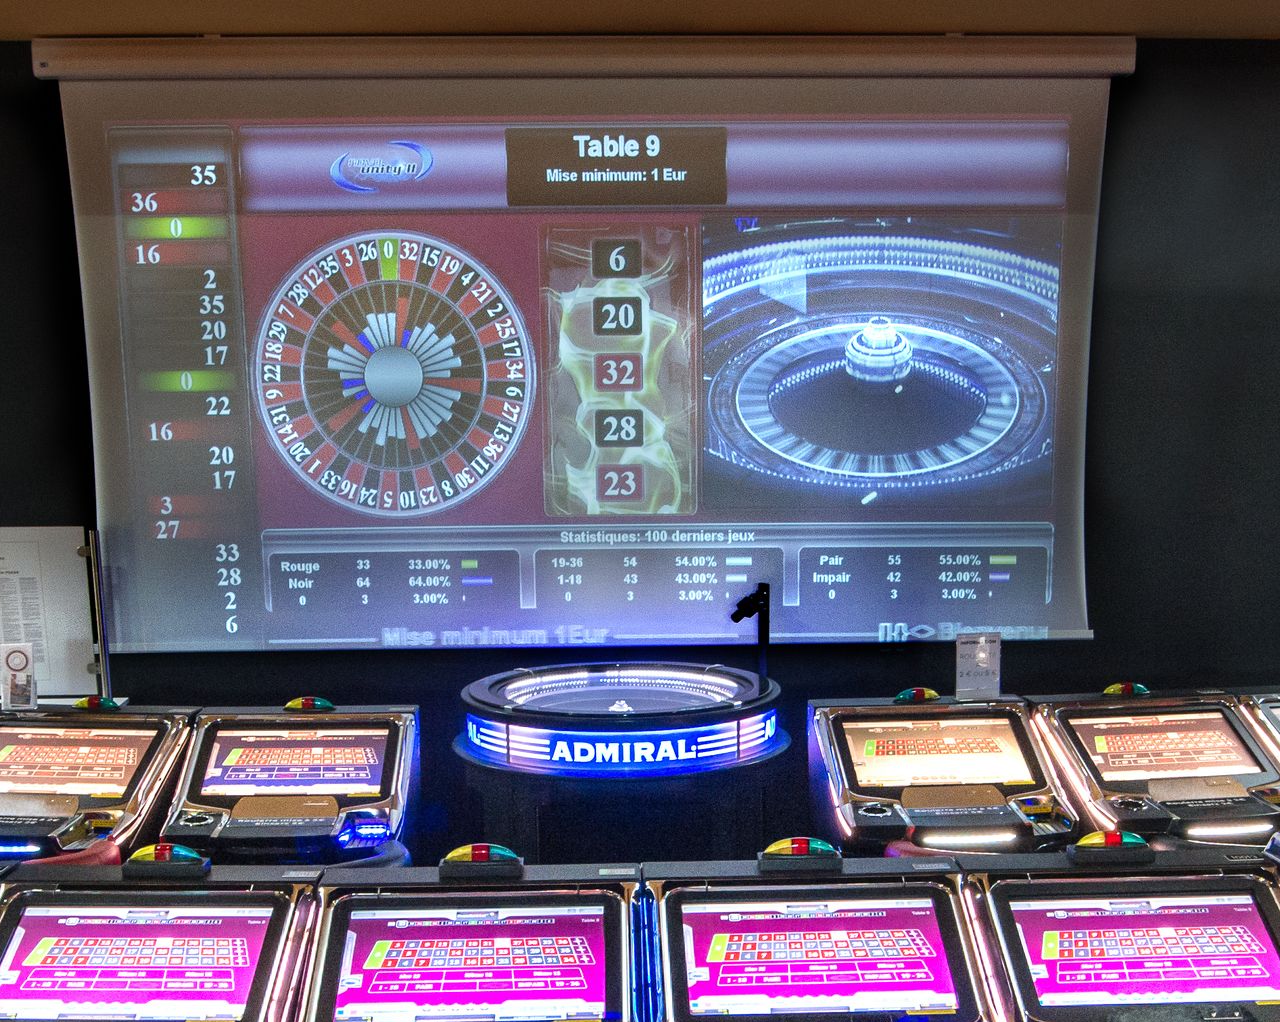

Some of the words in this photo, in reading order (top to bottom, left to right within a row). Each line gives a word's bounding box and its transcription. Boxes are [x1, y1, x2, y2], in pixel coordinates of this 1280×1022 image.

[573, 135, 640, 158] Table
[645, 135, 660, 158] 9
[191, 165, 217, 185] 35
[546, 168, 578, 182] Mise
[582, 168, 647, 182] minimum:
[652, 168, 659, 181] 1
[663, 168, 687, 181] Eur
[131, 192, 158, 212] 36
[170, 218, 182, 238] 0
[136, 244, 160, 264] 16
[342, 248, 353, 267] 3
[358, 241, 377, 261] 26
[383, 241, 393, 259] 0
[400, 242, 418, 261] 32
[422, 247, 441, 267] 15
[608, 247, 626, 271] 6
[319, 255, 340, 278] 35
[440, 255, 459, 275] 19
[203, 270, 216, 289] 2
[303, 269, 324, 290] 12
[461, 271, 475, 286] 4
[288, 284, 308, 306] 28
[471, 281, 493, 304] 21
[199, 295, 224, 315] 35
[278, 304, 295, 318] 7
[487, 303, 504, 318] 2
[601, 304, 635, 329] 20
[201, 321, 226, 340] 20
[268, 321, 287, 342] 29
[494, 318, 516, 339] 25
[205, 346, 228, 365] 17
[265, 342, 282, 361] 18
[502, 340, 521, 357] 17
[264, 364, 280, 382] 22
[505, 360, 524, 380] 34
[603, 361, 635, 385] 32
[180, 371, 192, 390] 0
[265, 389, 283, 400] 9
[505, 386, 523, 398] 6
[206, 397, 230, 415] 22
[270, 405, 289, 425] 31
[502, 401, 520, 423] 27
[149, 423, 173, 441] 16
[277, 423, 299, 444] 14
[493, 421, 513, 442] 13
[603, 416, 636, 441] 28
[209, 446, 234, 465] 20
[289, 442, 311, 463] 20
[483, 438, 504, 460] 36
[307, 459, 321, 474] 1
[470, 455, 490, 475] 11
[212, 471, 235, 489] 17
[320, 470, 341, 490] 33
[455, 467, 475, 489] 30
[604, 472, 636, 497] 23
[338, 480, 358, 499] 16
[359, 487, 377, 506] 24
[420, 486, 438, 506] 23
[441, 480, 453, 497] 8
[160, 497, 172, 514] 3
[383, 491, 393, 508] 5
[400, 490, 417, 508] 10
[155, 520, 180, 539] 27
[560, 531, 640, 545] Statistiques:
[645, 531, 668, 542] 100
[672, 530, 724, 542] derniers
[727, 530, 755, 544] jeux
[215, 544, 240, 562] 33
[551, 558, 583, 568] 19-36
[623, 557, 637, 567] 54
[675, 556, 717, 567] 54.00%
[820, 555, 843, 565] Pair
[888, 555, 901, 565] 55
[939, 555, 981, 566] 55.00%
[281, 561, 320, 573] Rouge
[356, 560, 370, 570] 33
[408, 559, 451, 570] 33.00%
[217, 568, 241, 586] 28
[288, 578, 314, 589] Noir
[356, 577, 371, 588] 64
[408, 576, 451, 587] 64.00%
[557, 575, 582, 585] 1-18
[623, 574, 638, 584] 43
[675, 574, 718, 584] 43.00%
[813, 572, 851, 584] Impair
[886, 572, 901, 583] 42
[938, 572, 981, 583] 42.00%
[225, 592, 237, 610] 2
[299, 595, 306, 605] 0
[361, 594, 368, 604] 3
[413, 594, 449, 604] 3.00%
[565, 592, 571, 601] 0
[627, 591, 634, 601] 3
[678, 591, 714, 601] 3.00%
[828, 589, 836, 599] 0
[890, 589, 898, 599] 3
[942, 589, 977, 599] 3.00%
[225, 615, 238, 633] 6
[382, 627, 436, 646] Mise
[551, 739, 696, 763] ADMIRAL
